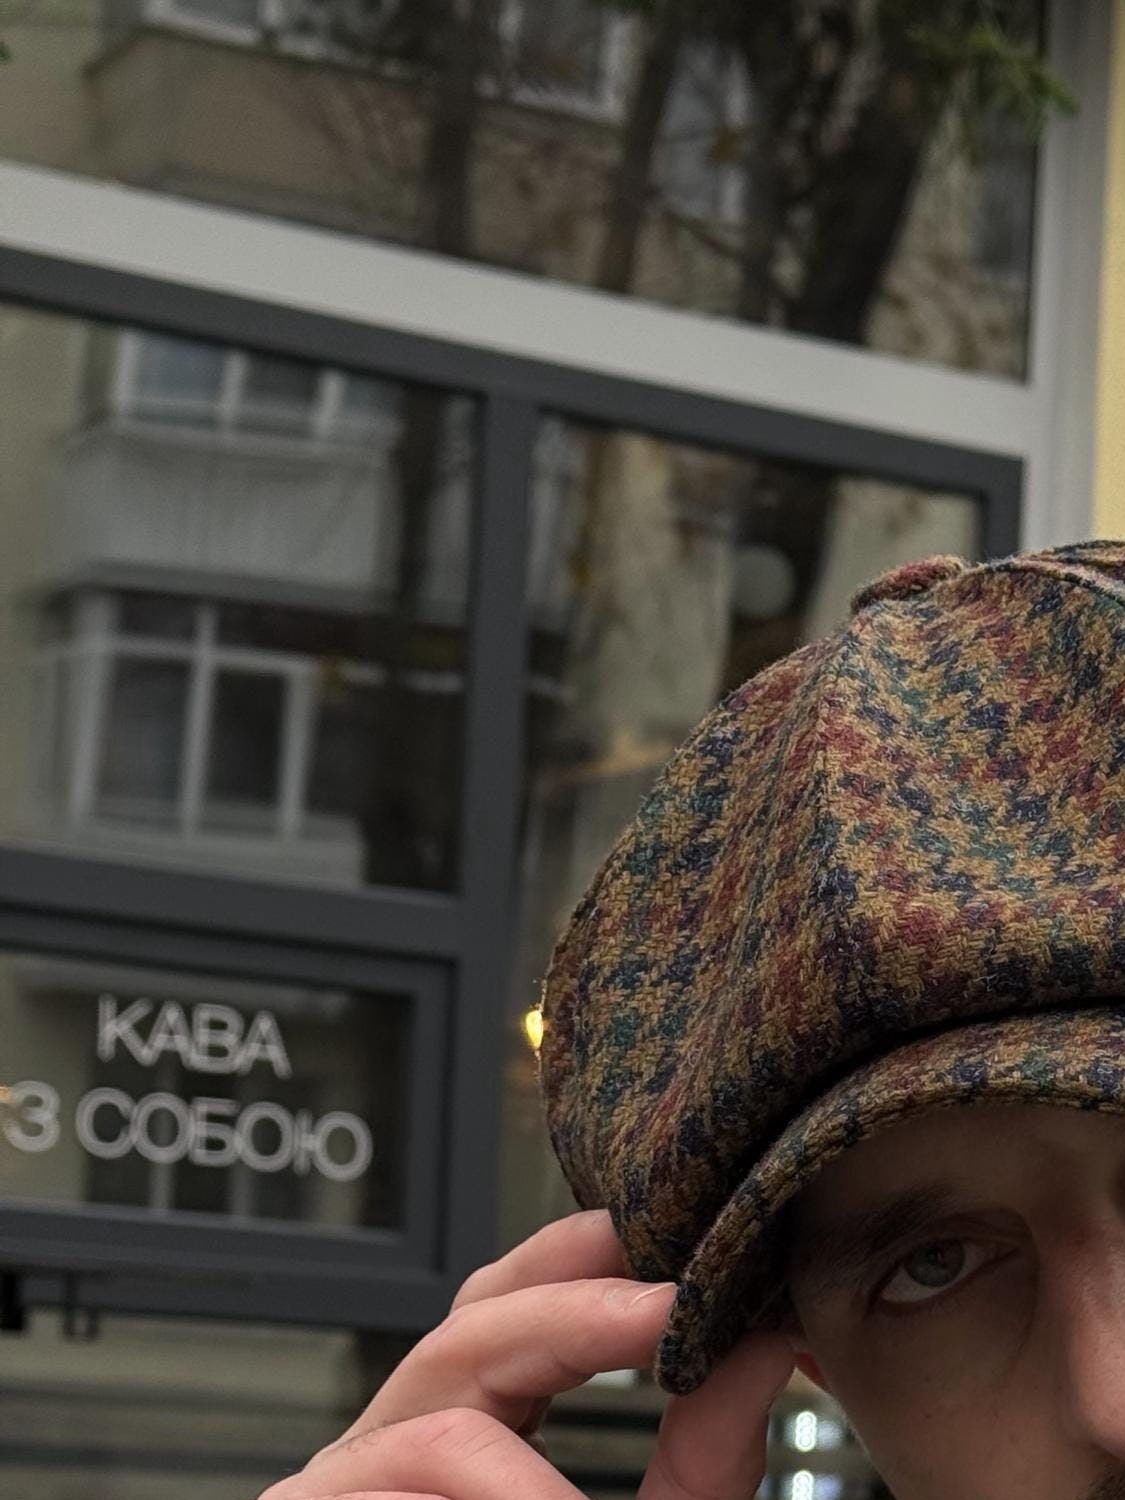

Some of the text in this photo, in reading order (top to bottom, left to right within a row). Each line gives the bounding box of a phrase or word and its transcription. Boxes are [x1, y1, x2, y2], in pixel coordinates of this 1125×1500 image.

[98, 995, 292, 1079] КАВА
[3, 1081, 373, 1181] З СОБОЮ
